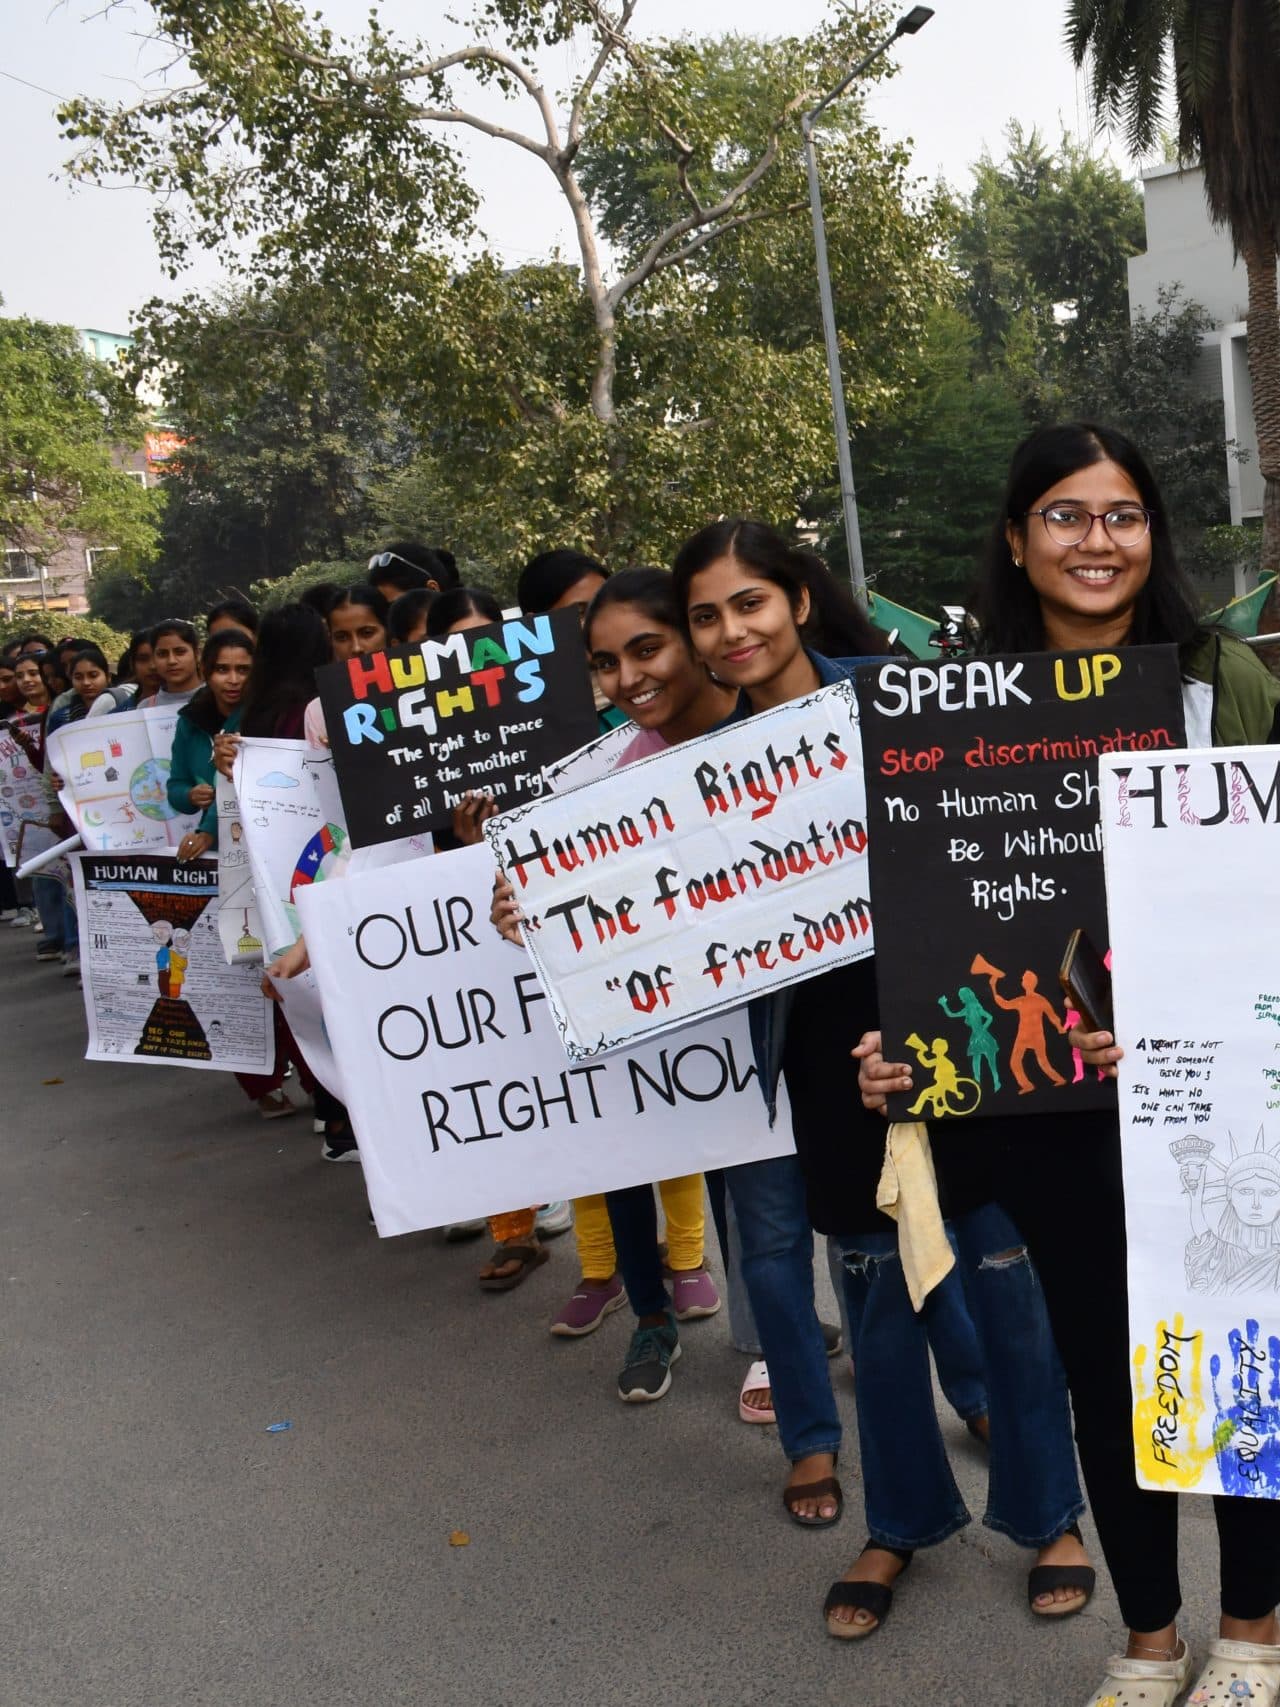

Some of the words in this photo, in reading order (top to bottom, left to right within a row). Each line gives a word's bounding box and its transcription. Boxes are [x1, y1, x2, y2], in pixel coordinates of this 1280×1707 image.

[347, 615, 555, 700] HUMAN
[343, 658, 545, 745] RIGHTS
[873, 660, 1032, 718] SPEAK
[1054, 653, 1122, 701] UP
[388, 747, 424, 766] The
[429, 733, 465, 762] right
[472, 729, 491, 745] to
[499, 717, 545, 745] peace
[880, 746, 945, 777] Stop
[963, 726, 1178, 769] discrimination
[414, 775, 429, 790] is
[435, 761, 463, 784] the
[468, 749, 527, 776] mother
[385, 804, 404, 826] of
[413, 796, 433, 820] all
[506, 796, 676, 890] Human
[693, 730, 849, 822] Rights
[936, 787, 1038, 819] Human
[223, 849, 249, 865] HOPE
[947, 838, 985, 863] Be
[94, 865, 159, 881] HUMAN
[702, 896, 873, 989] freedom
[377, 987, 506, 1061] OUR
[1135, 1037, 1147, 1051] A
[1200, 1040, 1224, 1049] NOT
[1147, 1056, 1170, 1065] WHAT
[1175, 1055, 1216, 1065] SOMEONE
[1159, 1068, 1182, 1078] GIVE
[1184, 1068, 1202, 1082] YOU
[421, 1063, 607, 1154] RIGHT
[1141, 1101, 1160, 1112] ONE
[1165, 1103, 1184, 1113] CAN
[1158, 1087, 1185, 1098] WHAT
[1188, 1086, 1203, 1098] NO
[1163, 1115, 1188, 1126] FROM
[1193, 1112, 1211, 1125] YOU
[1151, 1328, 1201, 1469] FREEDOM
[1236, 1336, 1267, 1483] EQUALITY
